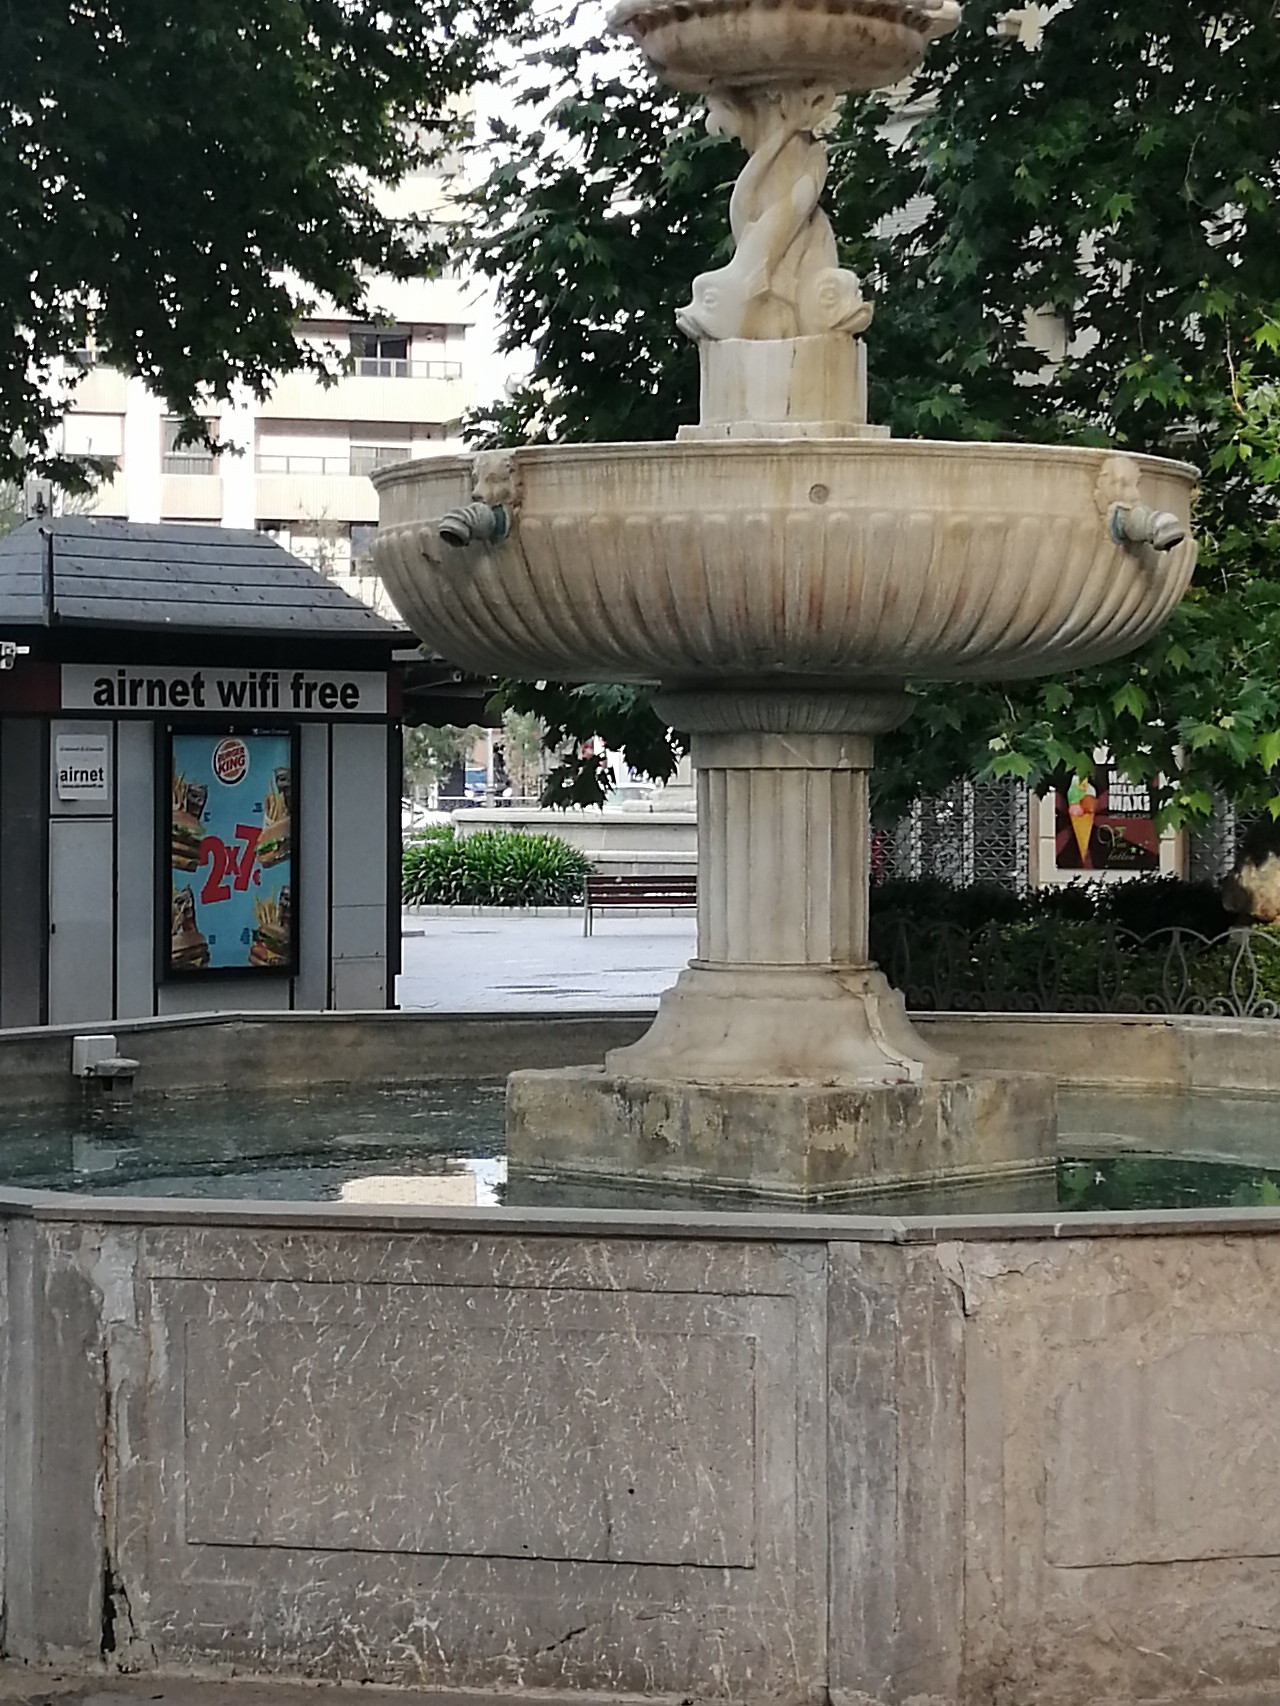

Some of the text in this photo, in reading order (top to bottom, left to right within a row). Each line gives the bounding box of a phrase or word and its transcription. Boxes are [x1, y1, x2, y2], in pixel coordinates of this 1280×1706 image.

[93, 669, 360, 709] airnet wifi free
[60, 766, 104, 782] airnet
[218, 754, 246, 774] KING
